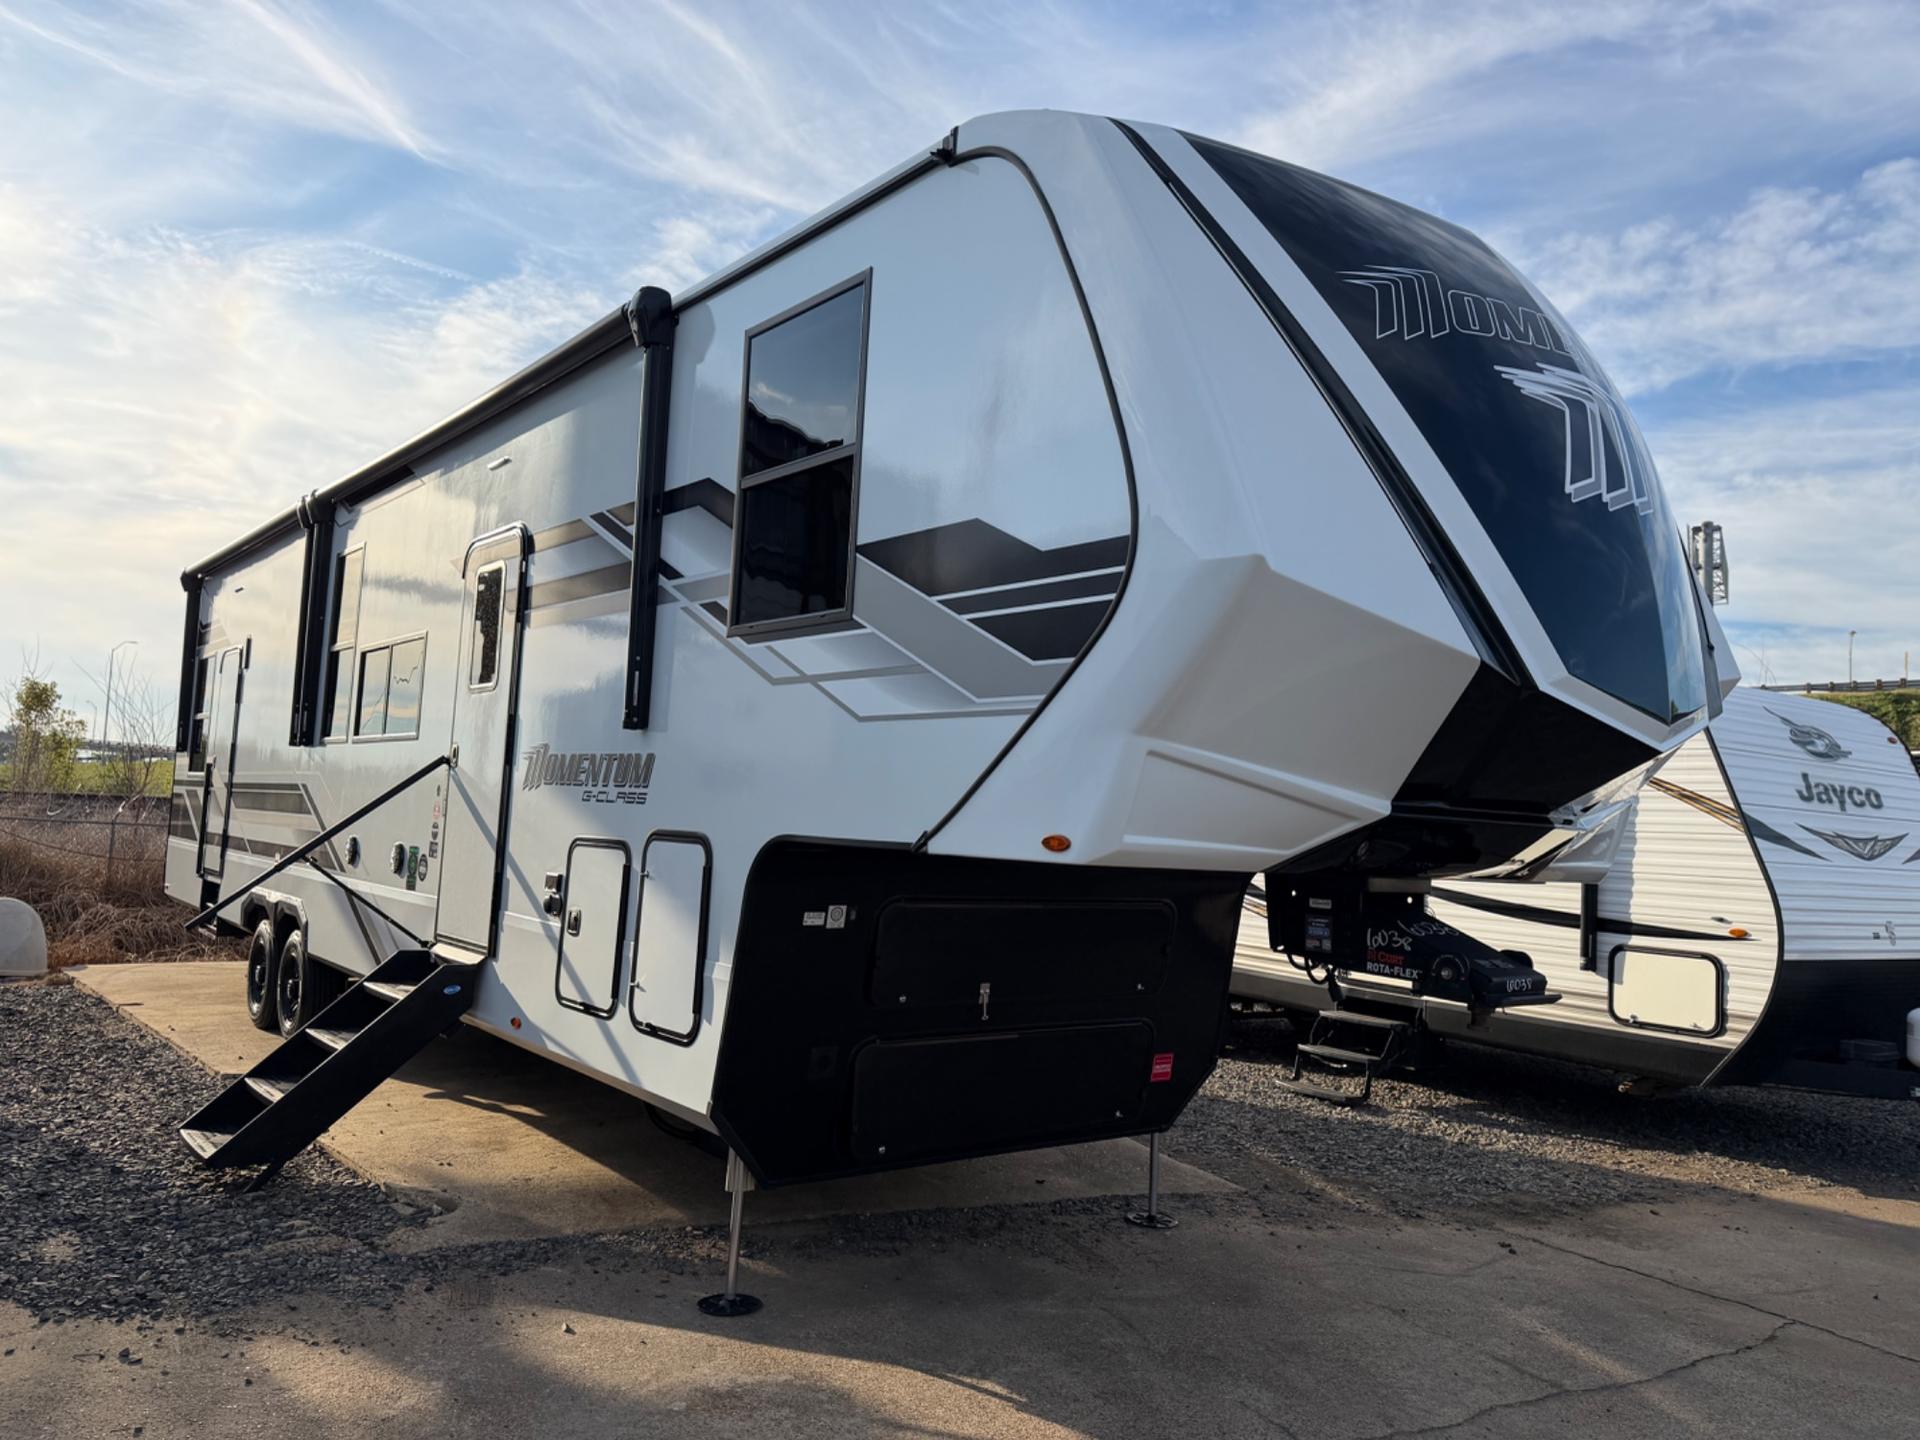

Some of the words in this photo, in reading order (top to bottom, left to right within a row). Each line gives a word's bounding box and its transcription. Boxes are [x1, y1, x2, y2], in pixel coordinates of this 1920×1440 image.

[522, 743, 656, 791] MOMENTUM
[581, 790, 648, 805] G-CLASS
[1795, 772, 1884, 812] Jayco
